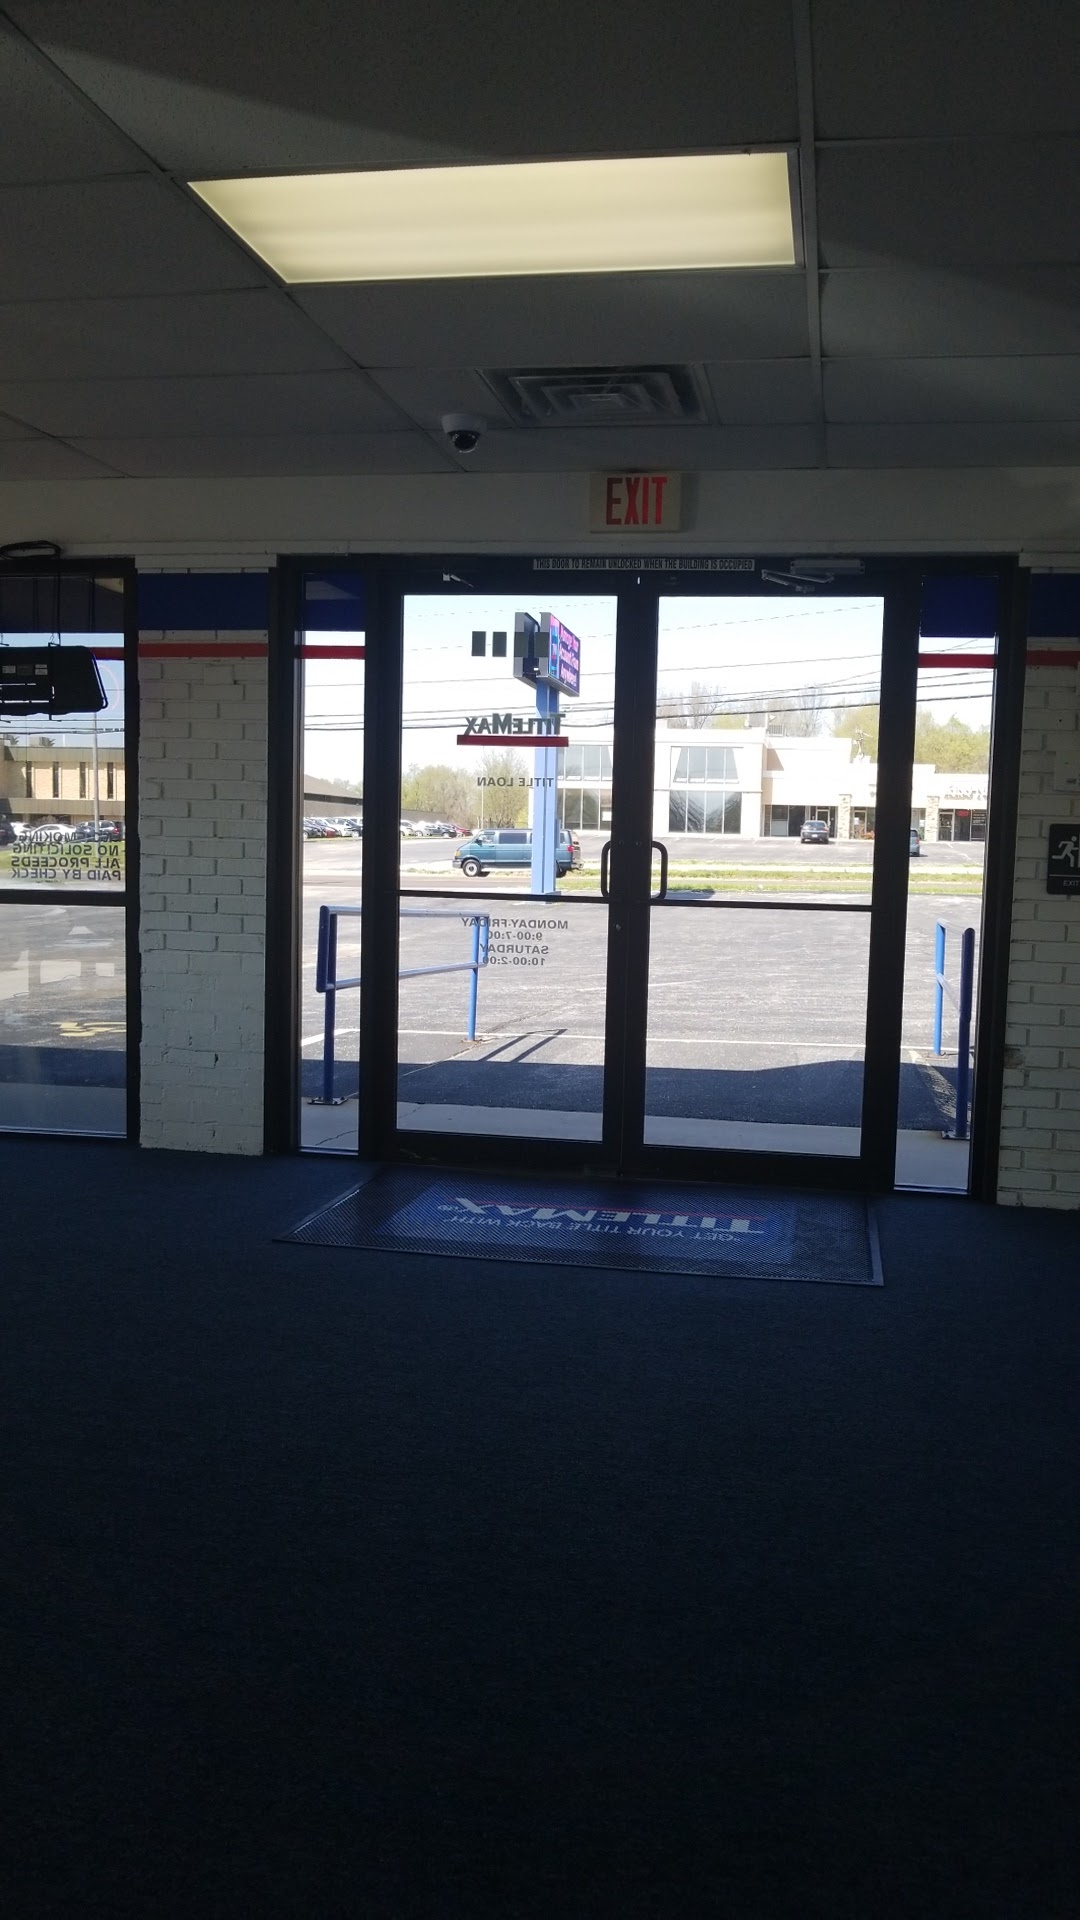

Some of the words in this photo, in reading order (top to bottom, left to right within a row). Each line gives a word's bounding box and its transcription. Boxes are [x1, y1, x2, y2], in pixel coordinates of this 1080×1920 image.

[606, 476, 668, 525] EXIT
[536, 559, 550, 569] THIS
[552, 559, 569, 569] DOOR
[571, 559, 579, 569] TO
[582, 559, 606, 569] REMAIN
[609, 559, 641, 569] UNLOCKED
[644, 559, 662, 569] WHEN
[665, 559, 676, 569] THE
[679, 559, 708, 569] BUILDING
[711, 559, 717, 569] IS
[719, 559, 753, 570] OCCUPIED
[505, 1219, 562, 1230] BACK
[567, 1222, 621, 1234] TITLE
[627, 1226, 684, 1238] YOUR
